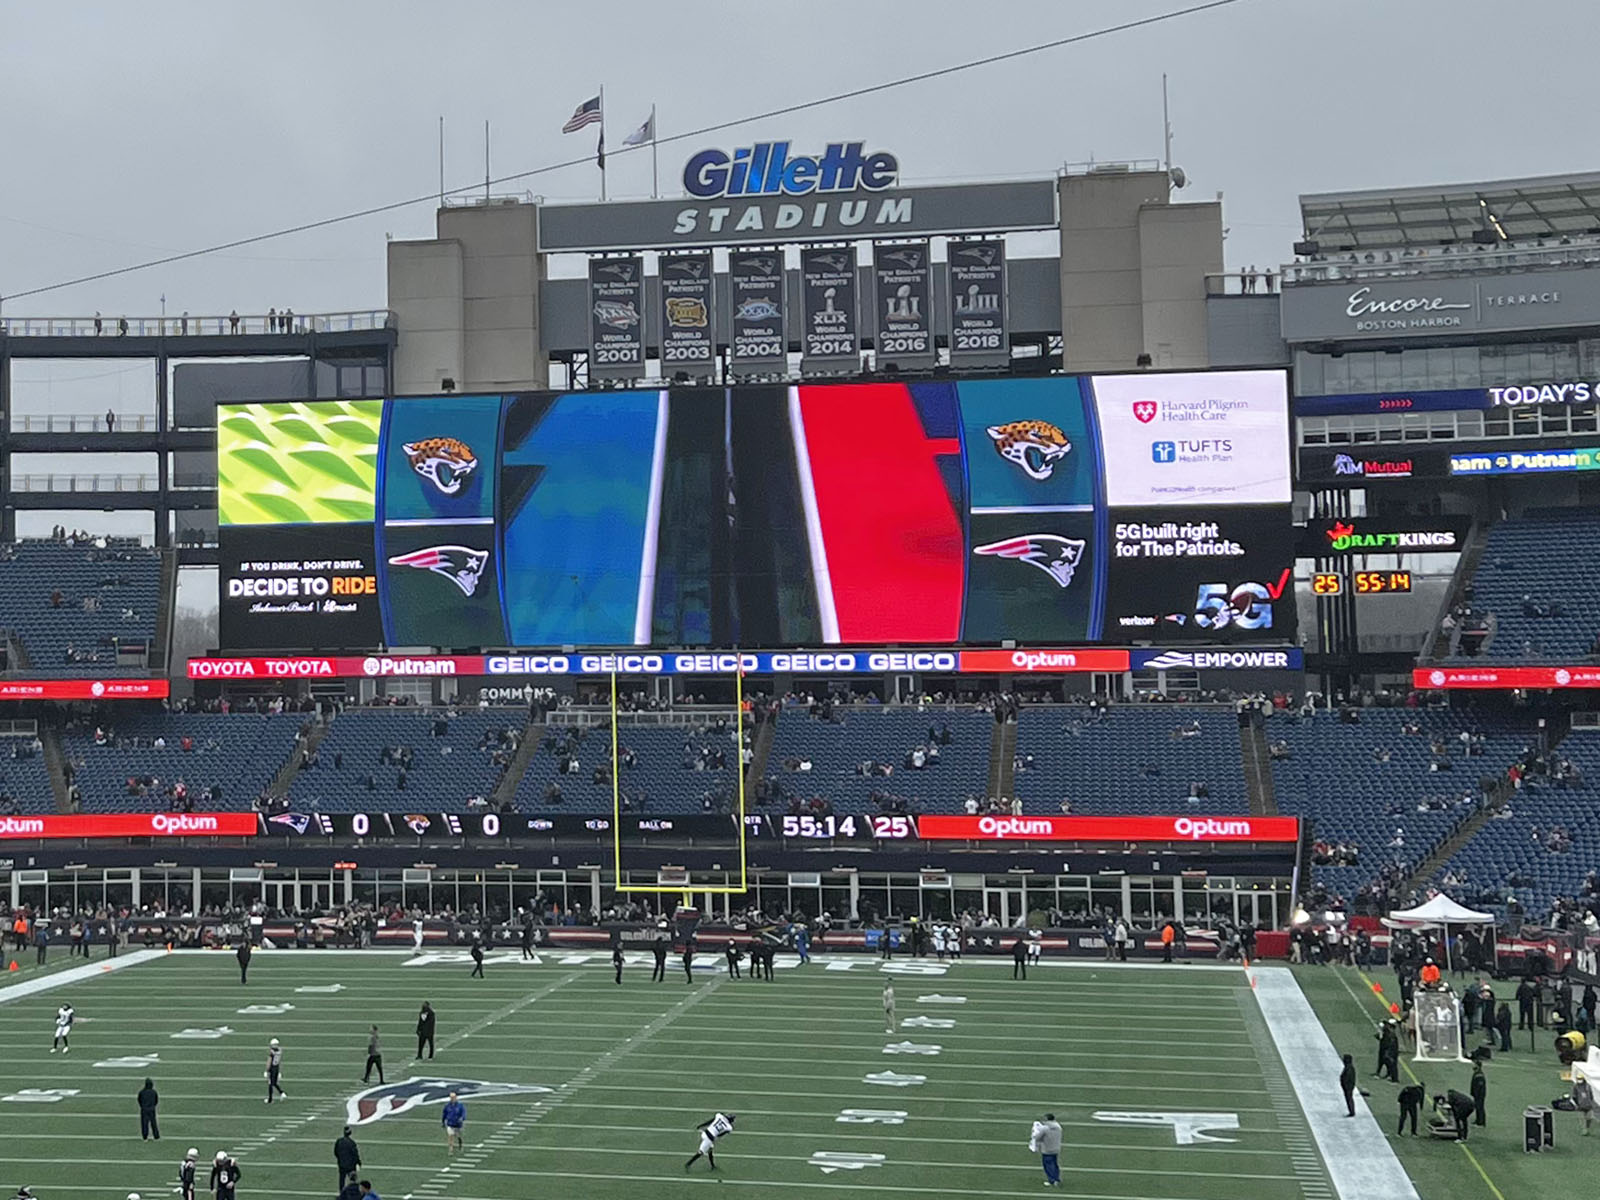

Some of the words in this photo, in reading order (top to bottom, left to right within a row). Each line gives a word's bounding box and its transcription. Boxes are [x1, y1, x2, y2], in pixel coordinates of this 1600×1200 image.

[682, 140, 898, 199] Gillette
[673, 198, 912, 234] STADIUM
[1346, 287, 1470, 317] Encore
[1487, 292, 1561, 306] TERRACE
[813, 314, 847, 324] XLIX
[1357, 319, 1406, 331] BOSTON
[1411, 316, 1461, 328] HARBOR
[743, 328, 774, 336] WORLD
[880, 331, 928, 339] CHAMPIONS
[953, 328, 1002, 336] CHAMPIONS
[594, 342, 640, 350] CHAMPIONS
[735, 336, 781, 344] CHAMPIONS
[884, 338, 926, 352] 2016
[958, 335, 1000, 349] 2018
[665, 347, 710, 359] 2003
[736, 344, 781, 356] 2004
[810, 341, 852, 354] 2014
[597, 350, 638, 362] 2001
[1490, 382, 1590, 406] TODAY'S
[1161, 400, 1207, 410] Harvard
[1208, 399, 1248, 411] Pilgrim
[1162, 411, 1200, 422] Health
[1200, 411, 1227, 421] Care
[1178, 440, 1232, 452] TUFTS
[1212, 454, 1232, 462] Plan
[1511, 453, 1590, 470] Putnam
[1364, 459, 1412, 473] Mutual
[1116, 523, 1141, 539] 5G
[1142, 523, 1178, 539] built
[1180, 522, 1219, 541] right
[1116, 542, 1140, 557] for
[1141, 541, 1174, 556] The
[1175, 540, 1245, 556] Patriots.
[251, 562, 270, 571] YOU
[272, 561, 302, 571] DRINK,
[304, 560, 331, 570] DON'T
[333, 559, 364, 569] DRIVE.
[229, 577, 299, 597] DECIDE
[300, 577, 329, 595] TO
[331, 576, 376, 594] RIDE
[1313, 575, 1339, 593] 25
[1356, 573, 1410, 592] 55:14
[1194, 582, 1273, 630] 5G
[1119, 616, 1155, 626] verizon
[381, 658, 456, 675] Putnam
[488, 656, 570, 673] GEICO
[580, 655, 663, 673] GEICO
[674, 655, 759, 672] GEICO
[770, 654, 856, 671] GEICO
[868, 653, 955, 671] GEICO
[1011, 652, 1076, 670] Optum
[1194, 652, 1288, 668] EMPOWER
[190, 661, 254, 675] TOYOTA
[266, 660, 332, 674] TOYOTA
[152, 814, 217, 833] Optum
[352, 813, 370, 835] 0
[482, 814, 500, 835] 0
[528, 820, 553, 829] DOWN
[585, 820, 595, 829] TO
[639, 820, 659, 829] BALL
[661, 820, 673, 829] ON
[783, 815, 857, 837] 55:14
[875, 817, 908, 837] 25
[979, 816, 1052, 837] Optum
[1175, 818, 1250, 839] Optum
